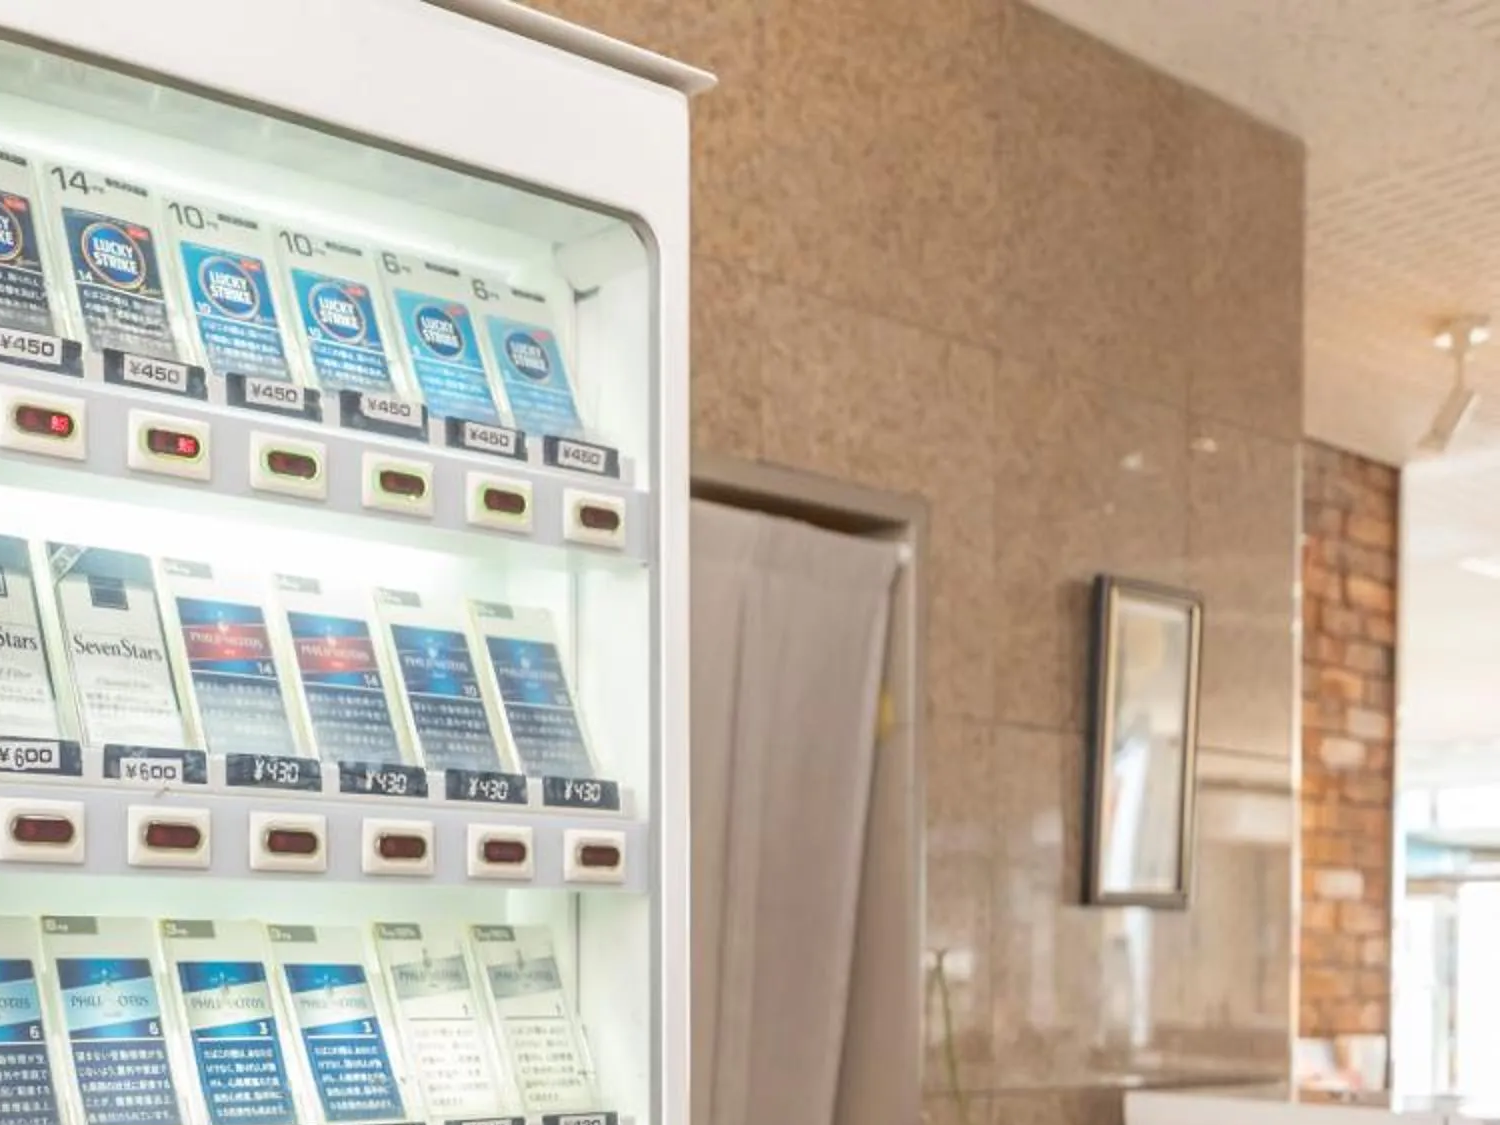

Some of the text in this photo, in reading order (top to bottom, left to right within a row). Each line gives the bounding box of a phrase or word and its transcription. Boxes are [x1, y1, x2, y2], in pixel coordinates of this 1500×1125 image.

[93, 236, 134, 258] LUCKY
[93, 251, 138, 275] STRIKE
[209, 270, 249, 293] LUCKY
[210, 284, 250, 305] STRIKE
[318, 295, 356, 315] LUCKY
[320, 309, 359, 329] STRIKE
[0, 334, 55, 357] ¥450
[129, 362, 180, 382] ¥450
[252, 384, 297, 405] ¥450
[367, 399, 411, 418] ¥450
[469, 429, 510, 448] ¥450
[562, 449, 602, 466] ¥450
[125, 762, 177, 781] ¥600
[254, 759, 300, 783] ¥430
[365, 771, 407, 794] ¥430
[468, 777, 509, 800] ¥430
[564, 782, 601, 802] ¥430
